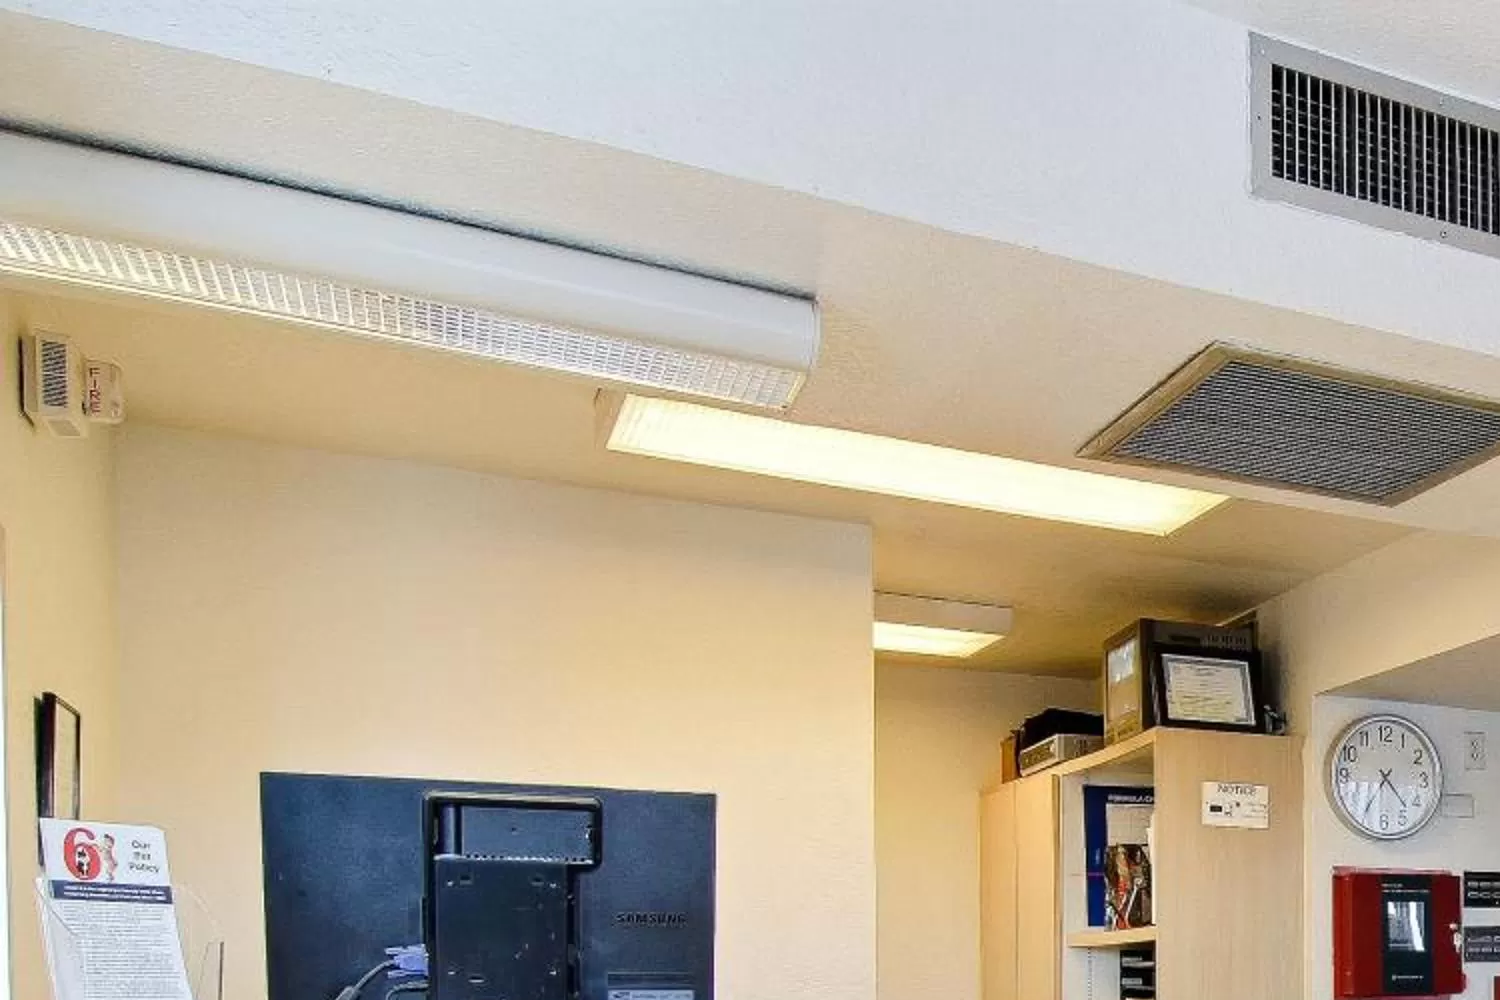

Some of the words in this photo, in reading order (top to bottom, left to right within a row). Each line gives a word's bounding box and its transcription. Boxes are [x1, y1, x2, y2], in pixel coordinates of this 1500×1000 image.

[88, 366, 101, 413] FIRE
[1359, 731, 1369, 747] 11
[1378, 725, 1393, 743] 12
[1342, 744, 1357, 762] 10
[1413, 749, 1423, 765] 2
[1340, 767, 1349, 784] 9
[1419, 771, 1429, 788] 3
[131, 839, 152, 849] Our
[63, 827, 102, 881] 6
[615, 911, 688, 925] SAMSUNG
